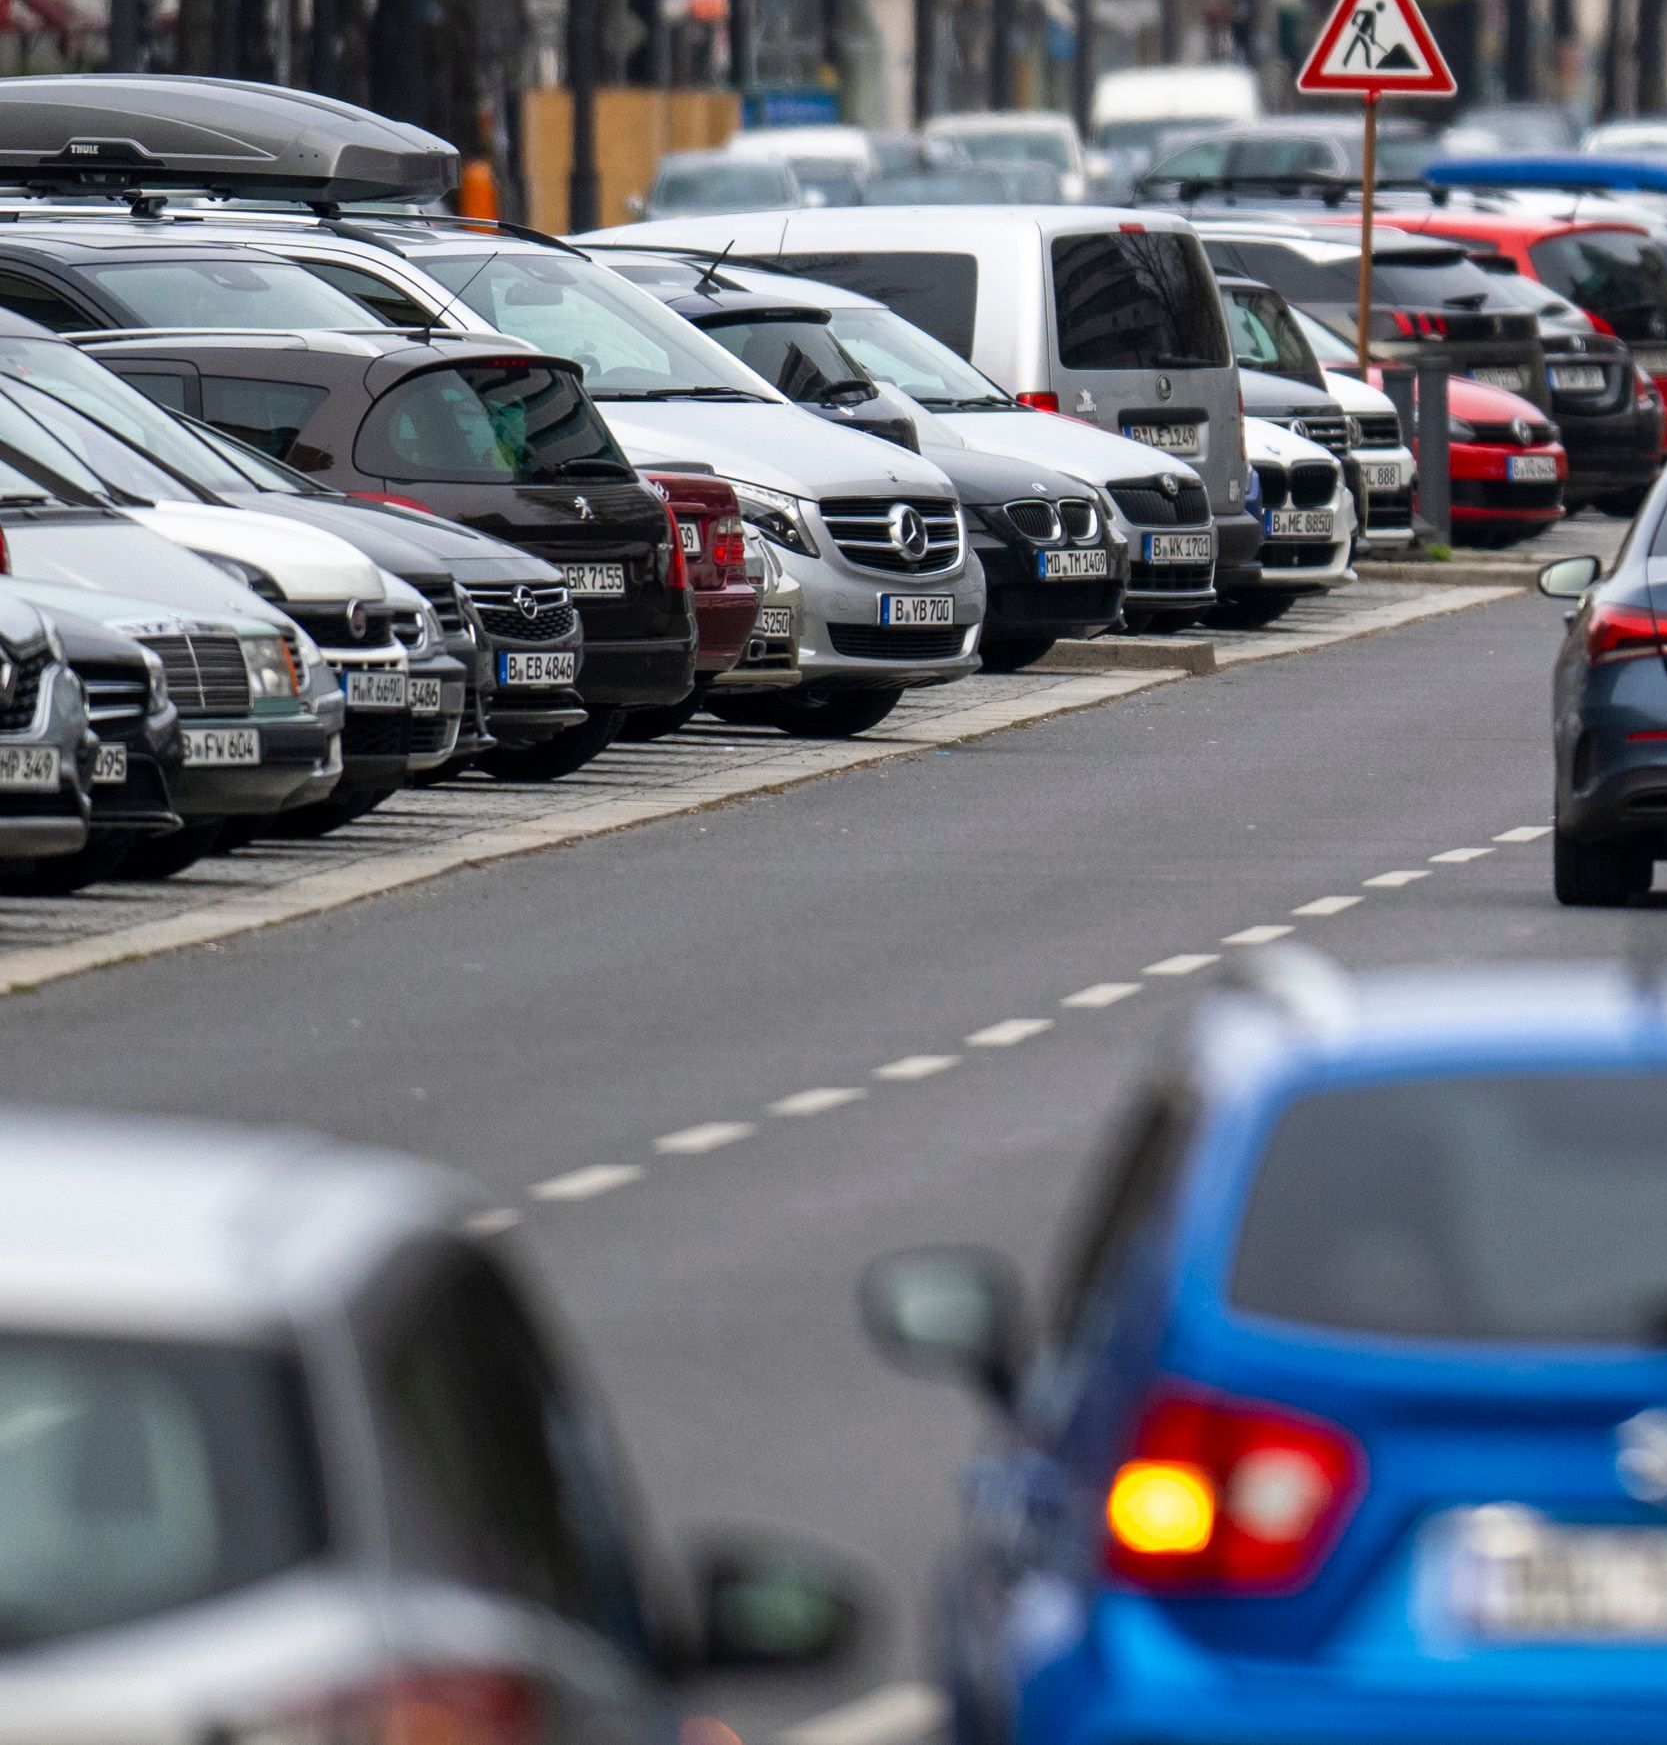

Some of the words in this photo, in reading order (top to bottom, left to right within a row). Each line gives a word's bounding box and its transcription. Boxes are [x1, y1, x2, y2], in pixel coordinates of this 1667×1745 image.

[71, 144, 98, 154] THULE
[1169, 425, 1196, 446] 1249
[1378, 468, 1396, 486] 888
[1272, 513, 1281, 533] B
[1289, 512, 1303, 532] ME
[1305, 512, 1331, 533] 8850
[1153, 537, 1161, 556] B
[1186, 536, 1209, 556] 1701
[1046, 554, 1062, 575] MD
[1084, 551, 1106, 573] 1409
[589, 567, 623, 589] 7155
[896, 601, 904, 620] B
[913, 601, 927, 621] YB
[930, 600, 949, 621] 700
[509, 657, 517, 679] B
[526, 657, 542, 679] EB
[545, 657, 572, 679] 4846
[228, 733, 253, 758] 604
[23, 749, 51, 779] 349
